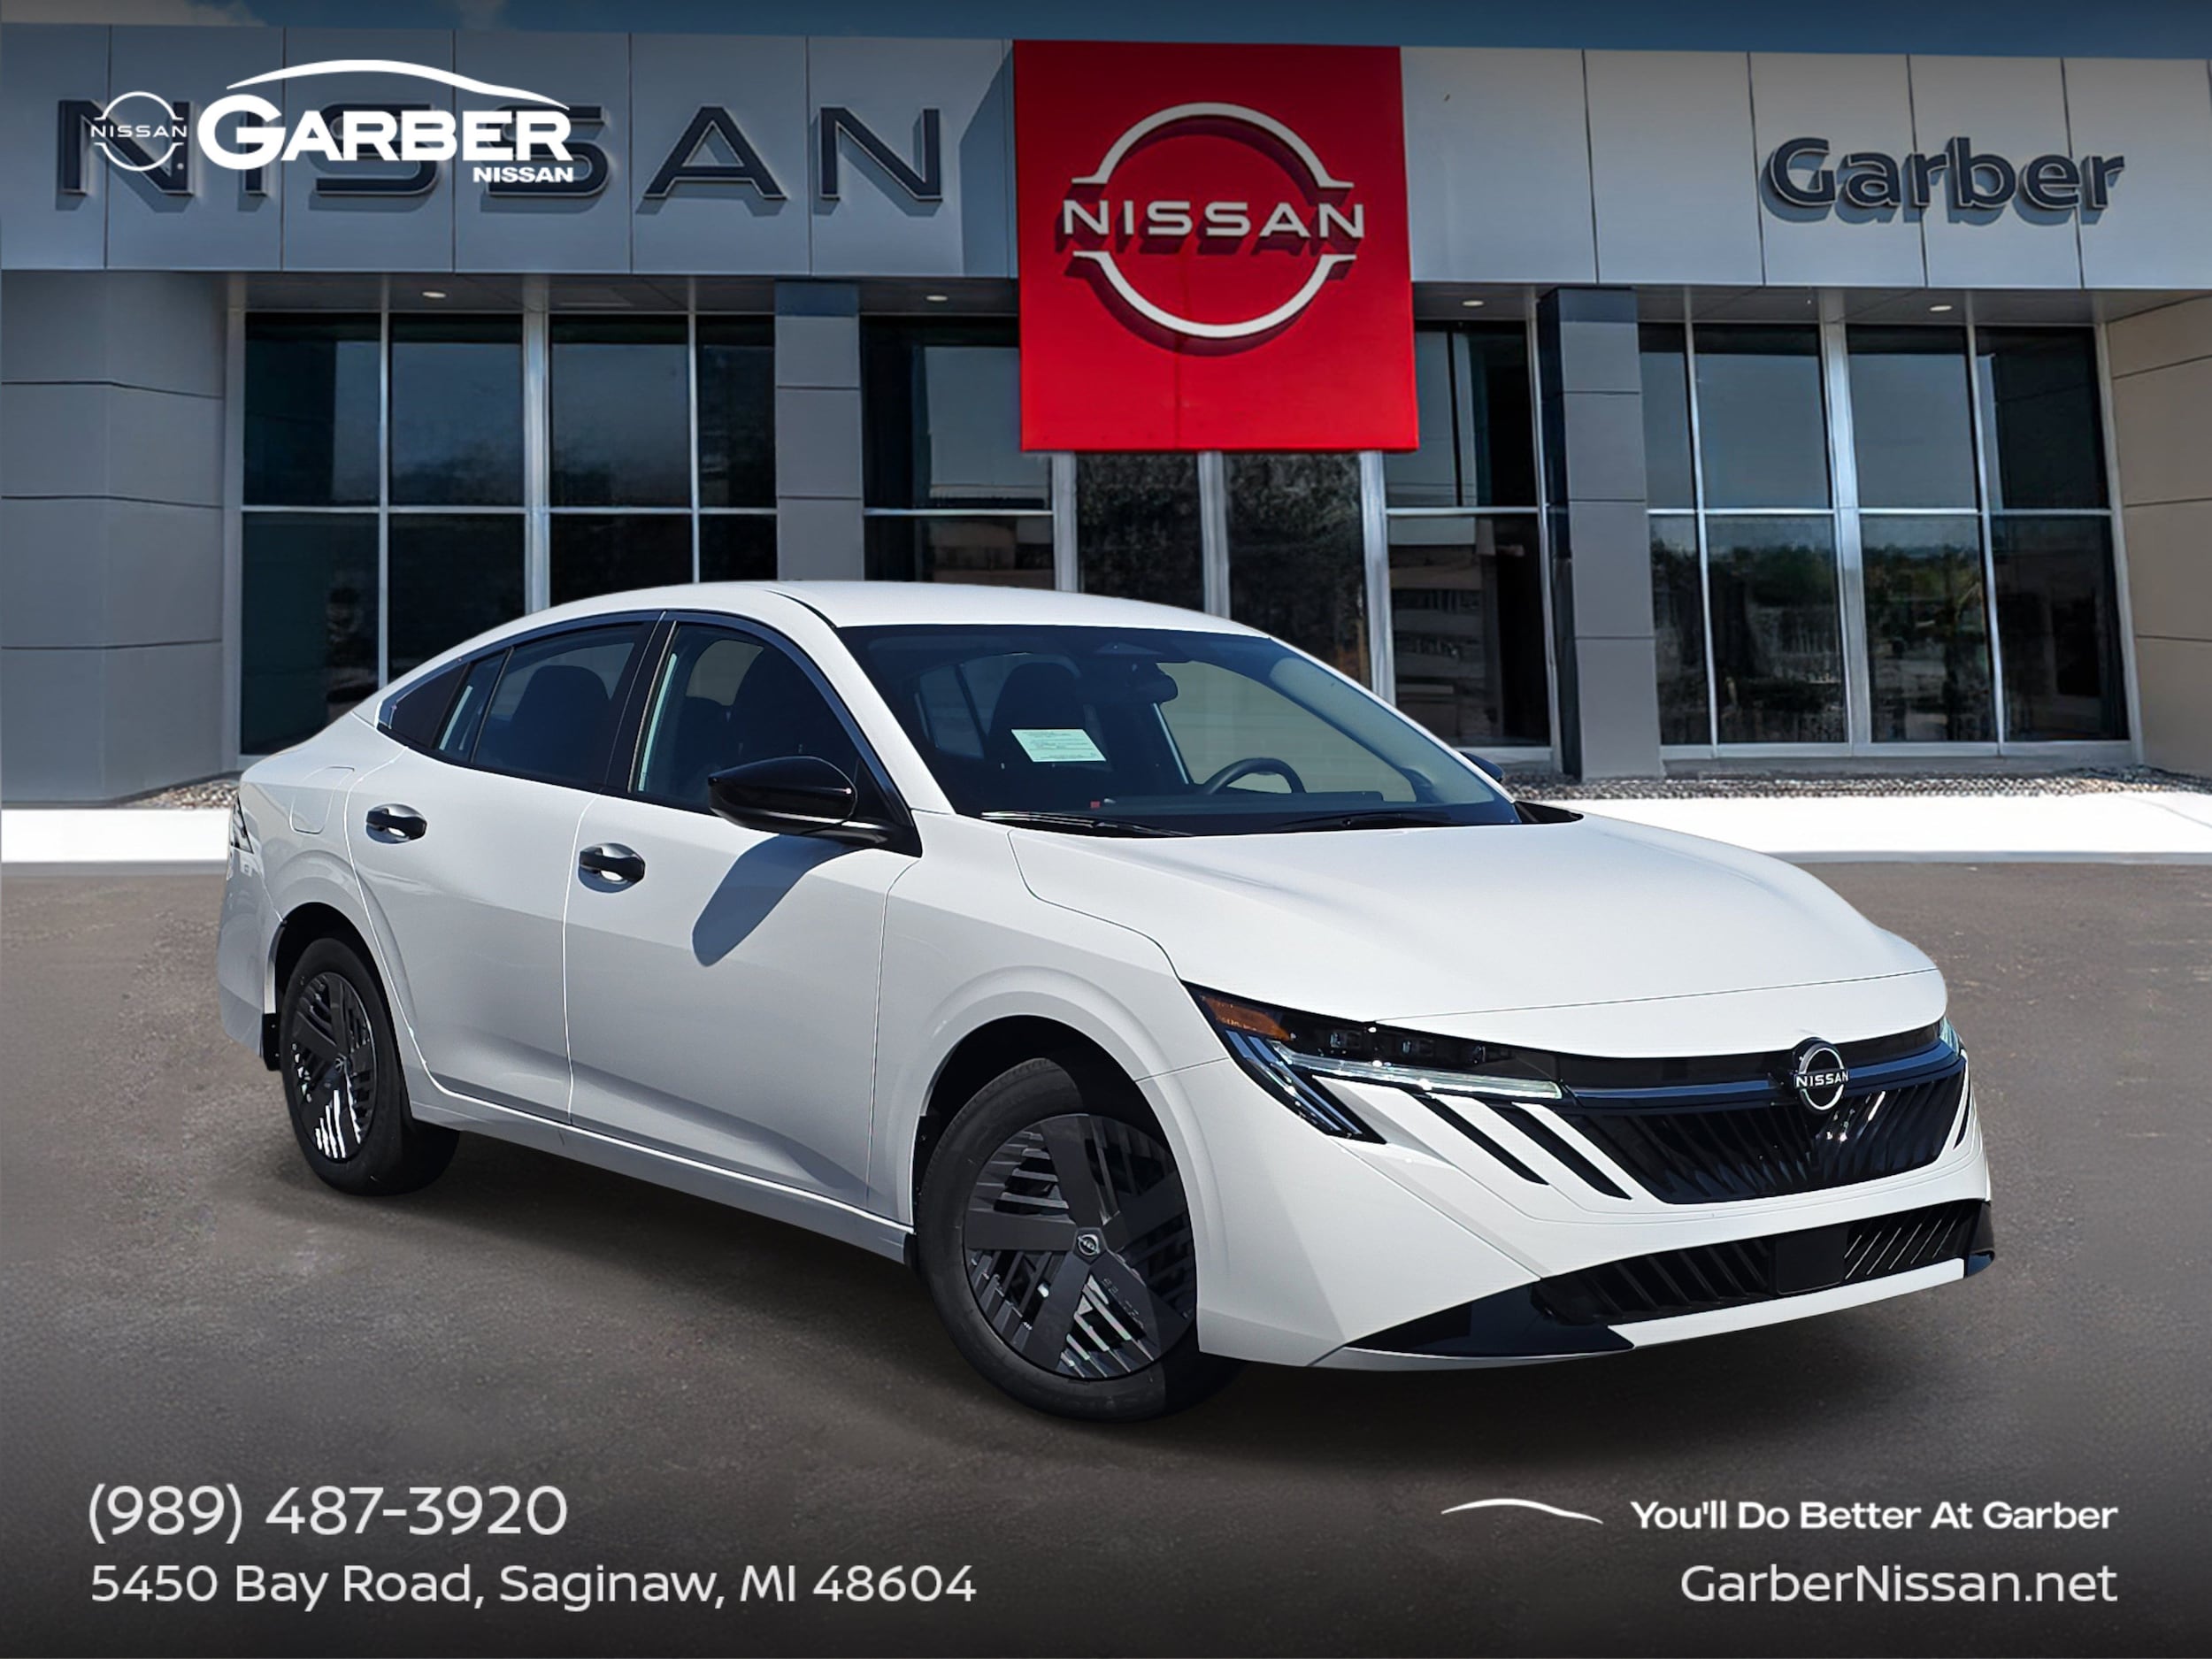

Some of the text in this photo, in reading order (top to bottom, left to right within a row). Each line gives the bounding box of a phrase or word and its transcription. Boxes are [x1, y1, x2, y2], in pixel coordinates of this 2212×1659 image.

[1770, 136, 2124, 210] Garber
[1063, 199, 1365, 238] NISSAN
[1795, 1070, 1849, 1087] NISSAN
